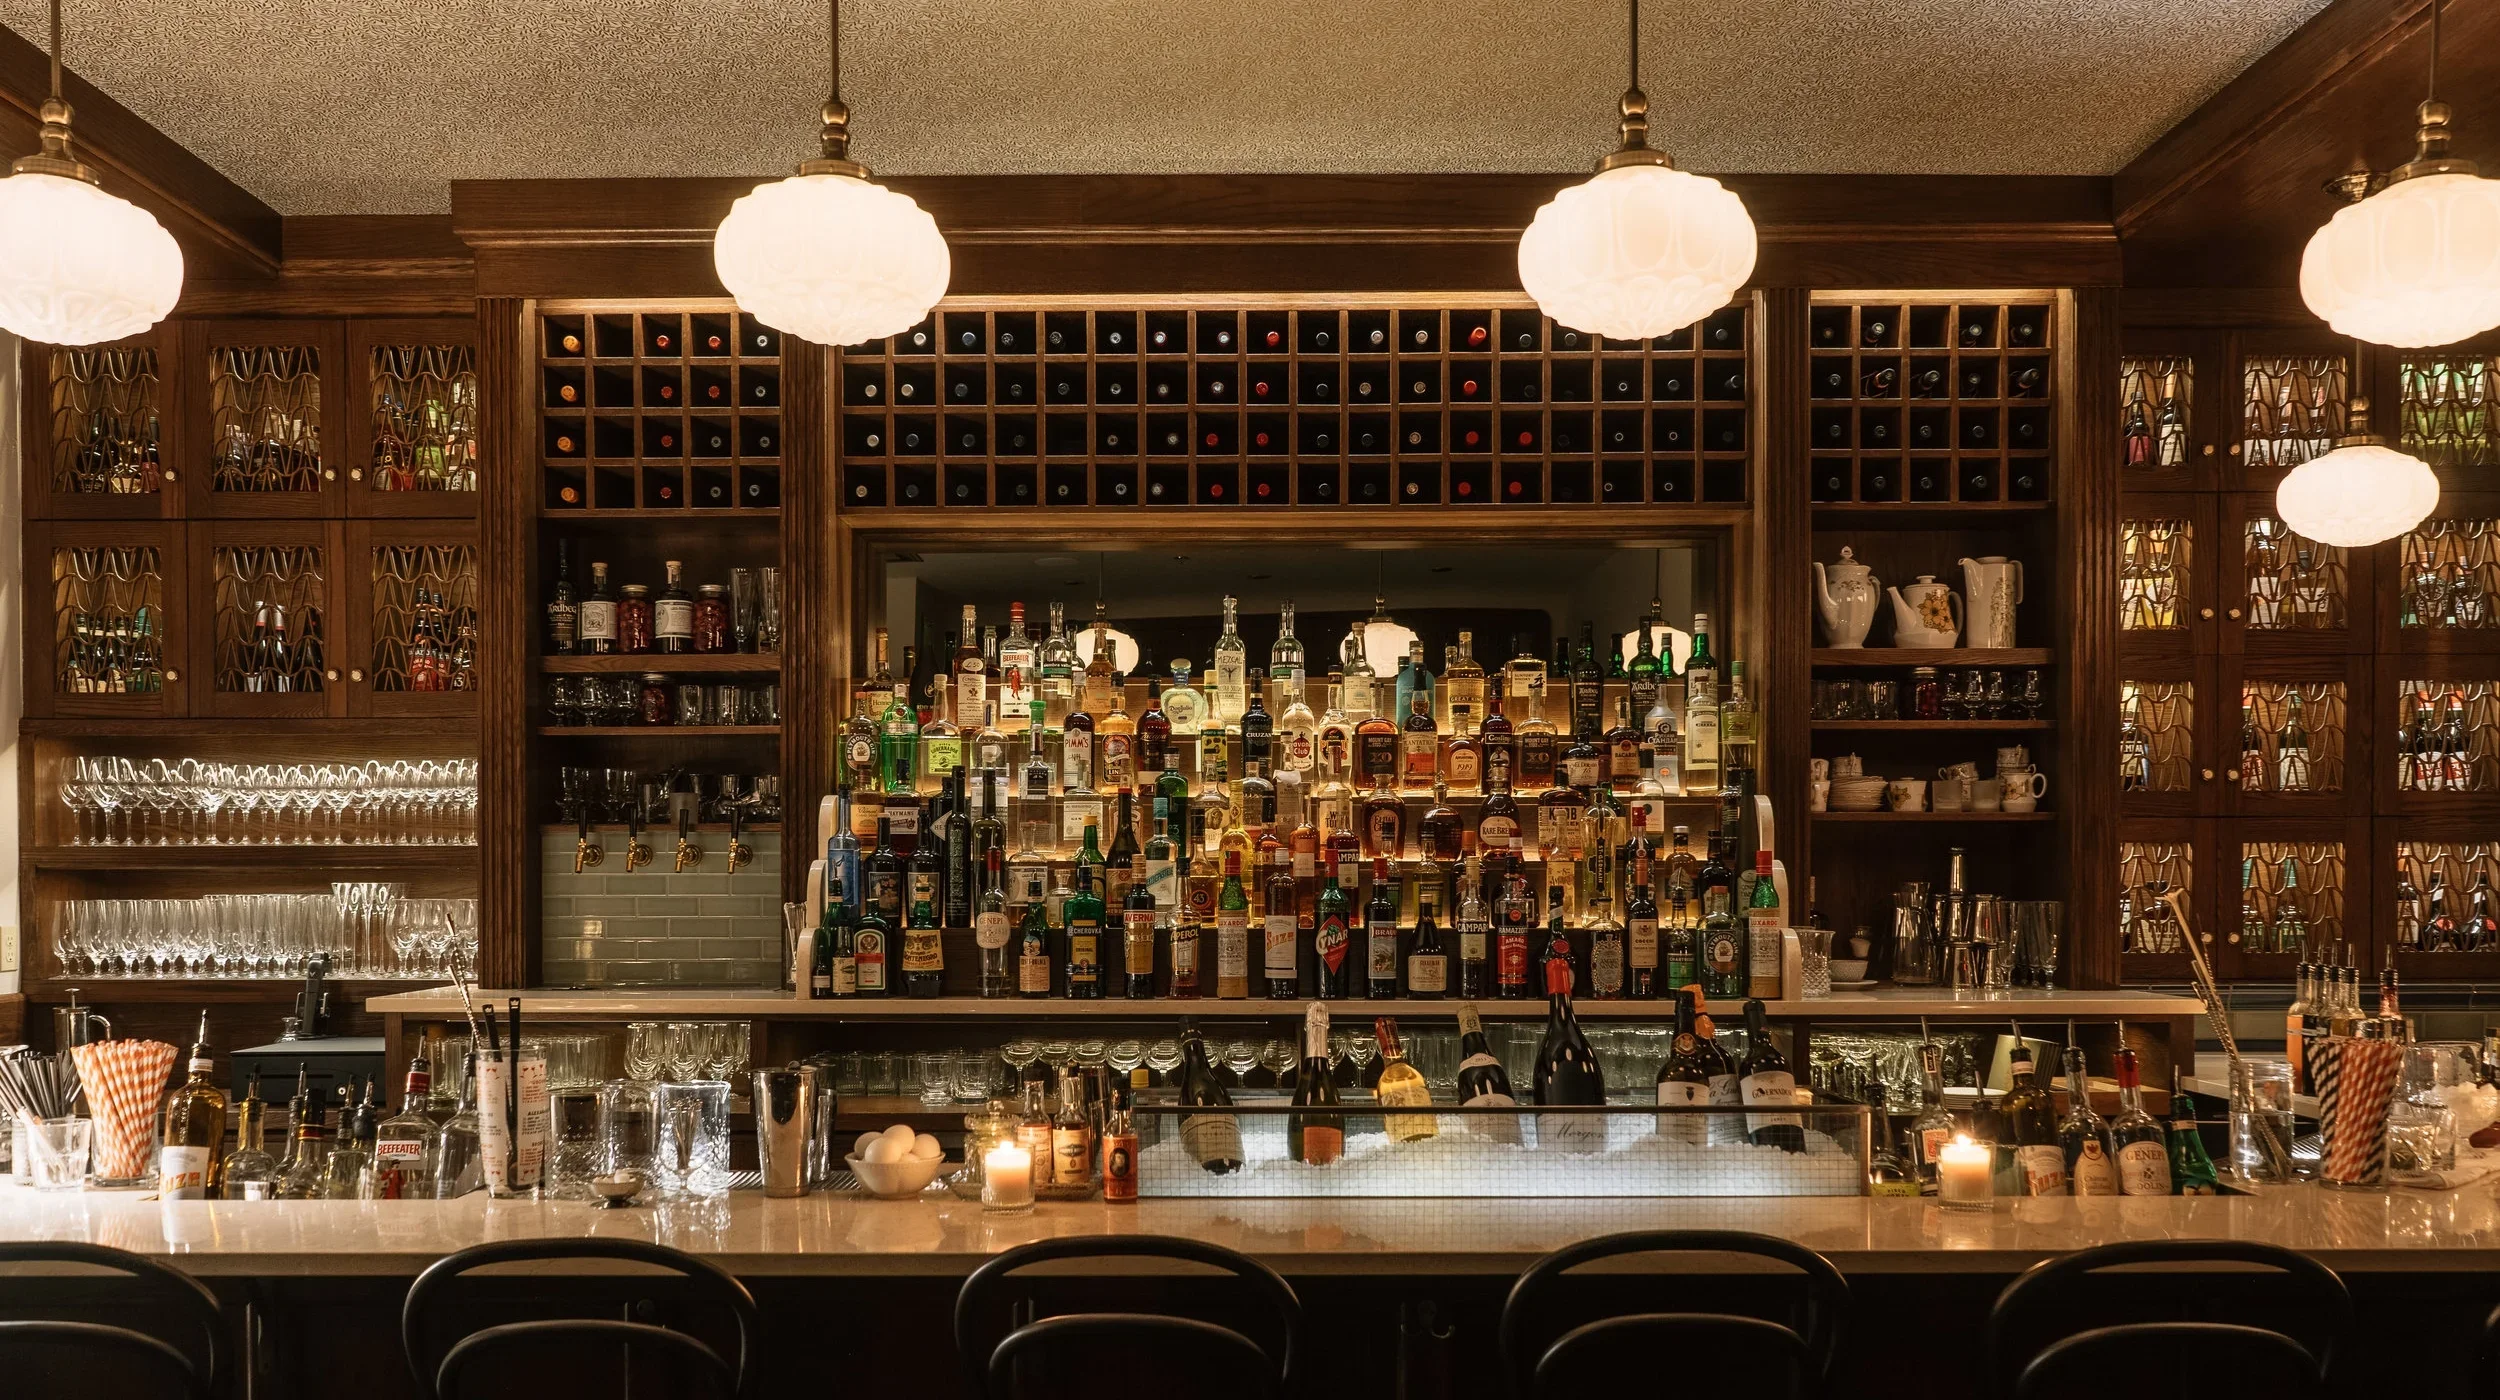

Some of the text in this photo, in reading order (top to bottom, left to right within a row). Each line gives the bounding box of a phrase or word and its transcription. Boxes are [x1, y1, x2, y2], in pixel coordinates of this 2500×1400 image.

[1218, 656, 1242, 664] MEZCAL
[1065, 737, 1089, 748] PIMM'S
[1482, 826, 1510, 834] RARE BREE
[1193, 894, 1205, 902] 43
[1125, 913, 1153, 922] AVERNA
[1171, 928, 1199, 941] APEROL
[904, 953, 937, 962] ONTENEGRO
[377, 1144, 421, 1156] BEEFEATER
